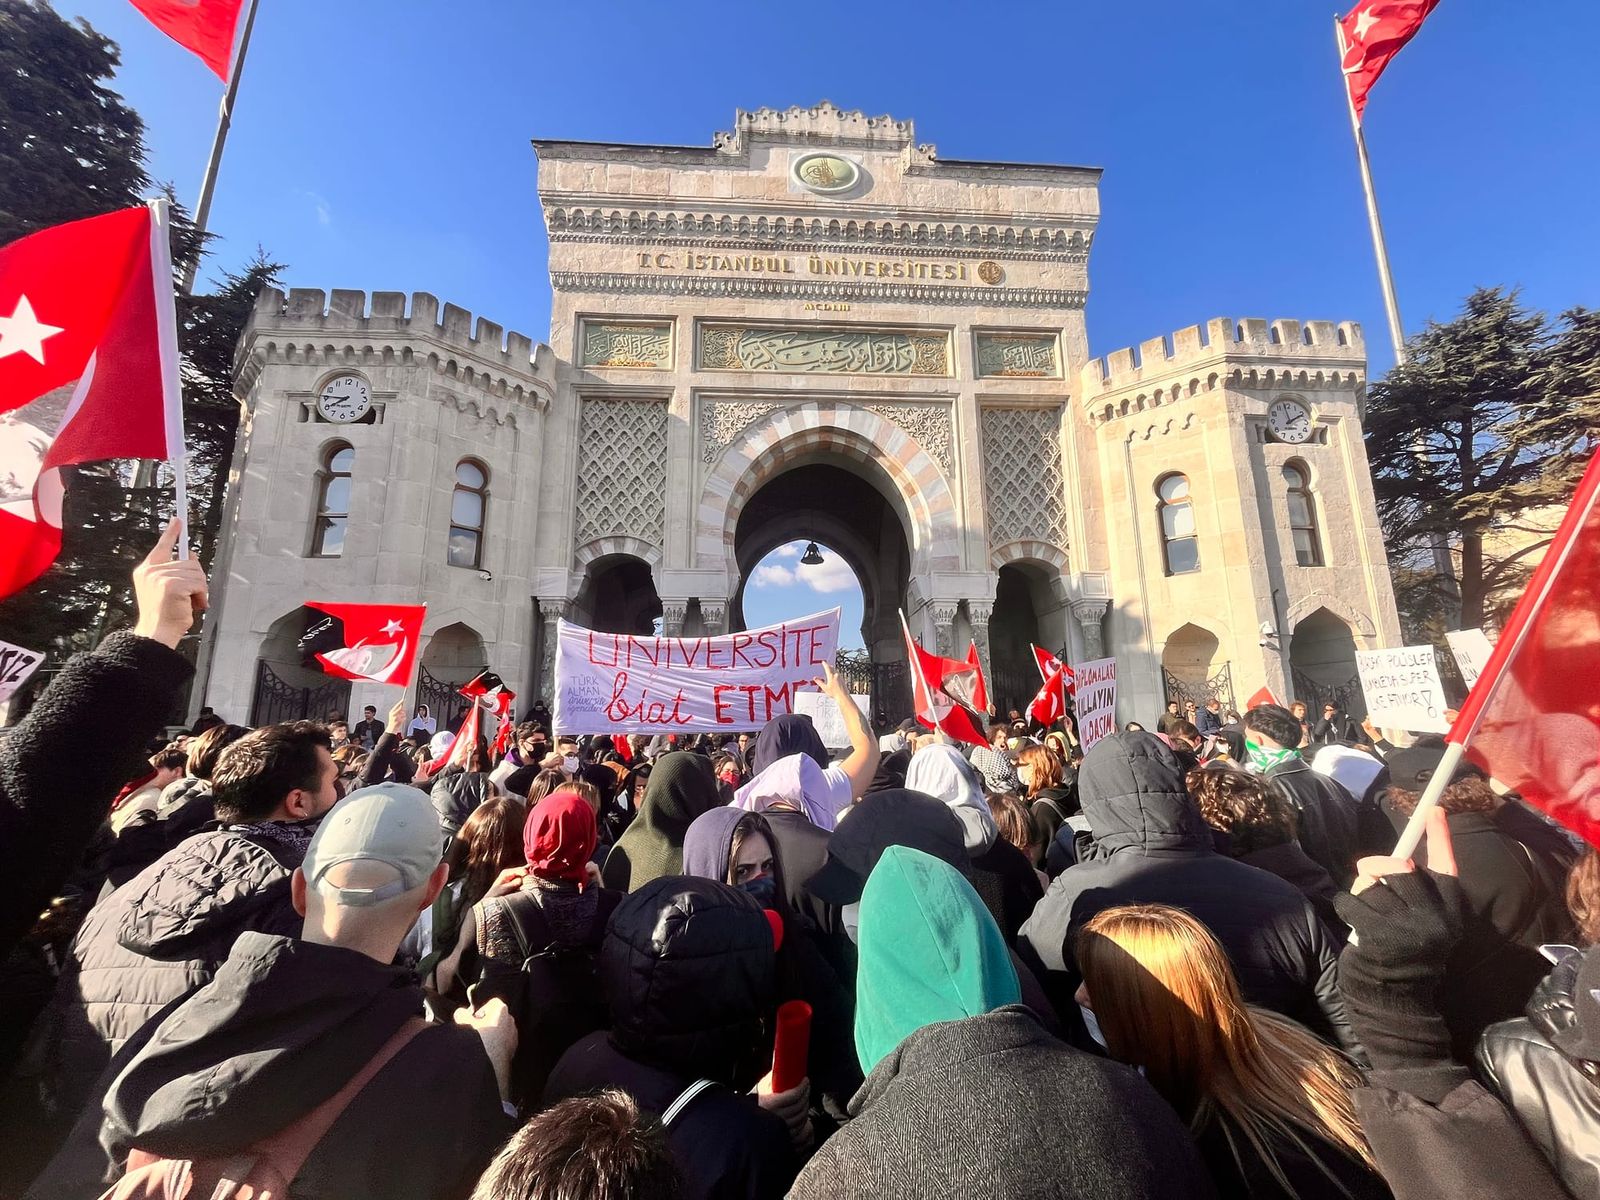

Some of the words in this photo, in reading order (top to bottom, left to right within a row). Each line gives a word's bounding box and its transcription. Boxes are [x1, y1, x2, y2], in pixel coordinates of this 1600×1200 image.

[685, 250, 795, 274] İSTANBUL
[807, 254, 968, 281] ÜNİVERSİTESİ
[345, 378, 353, 386] 12
[568, 686, 600, 697] ALMAN
[603, 671, 692, 725] biat
[713, 679, 826, 723] ETM
